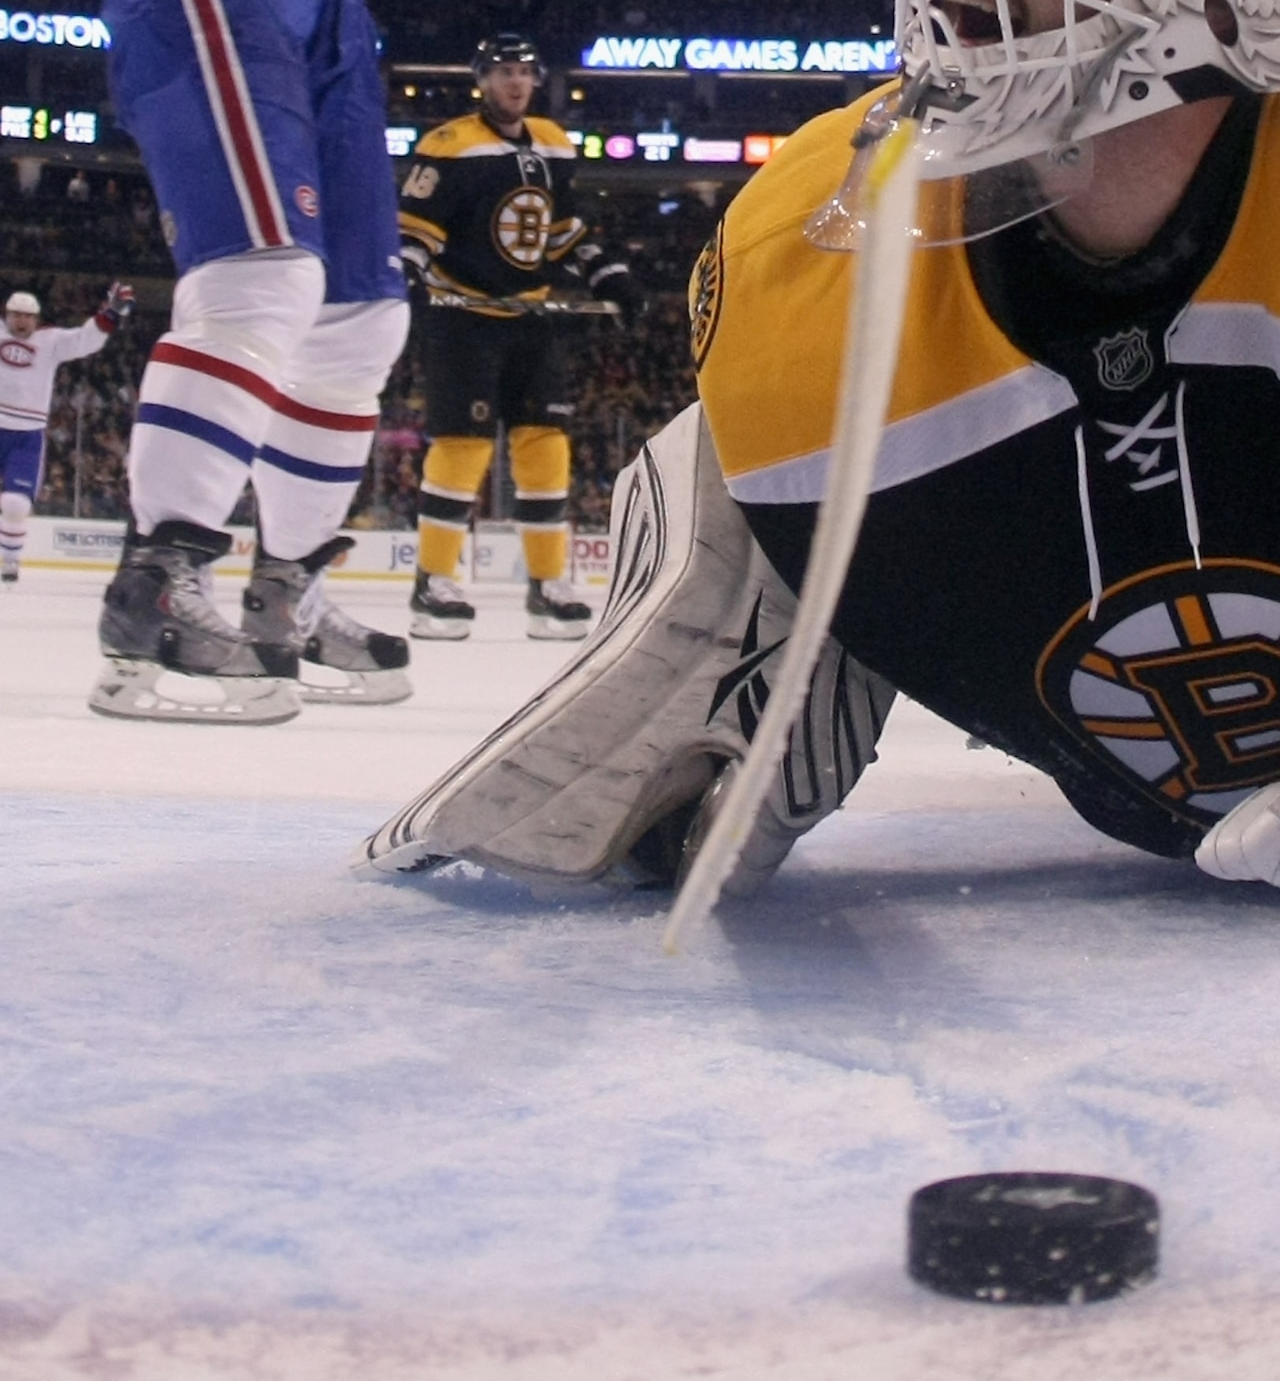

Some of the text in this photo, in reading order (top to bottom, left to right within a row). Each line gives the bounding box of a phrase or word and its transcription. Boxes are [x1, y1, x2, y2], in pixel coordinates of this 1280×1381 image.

[588, 37, 899, 71] AWAY GAMES AREN'
[1111, 340, 1145, 381] NHL
